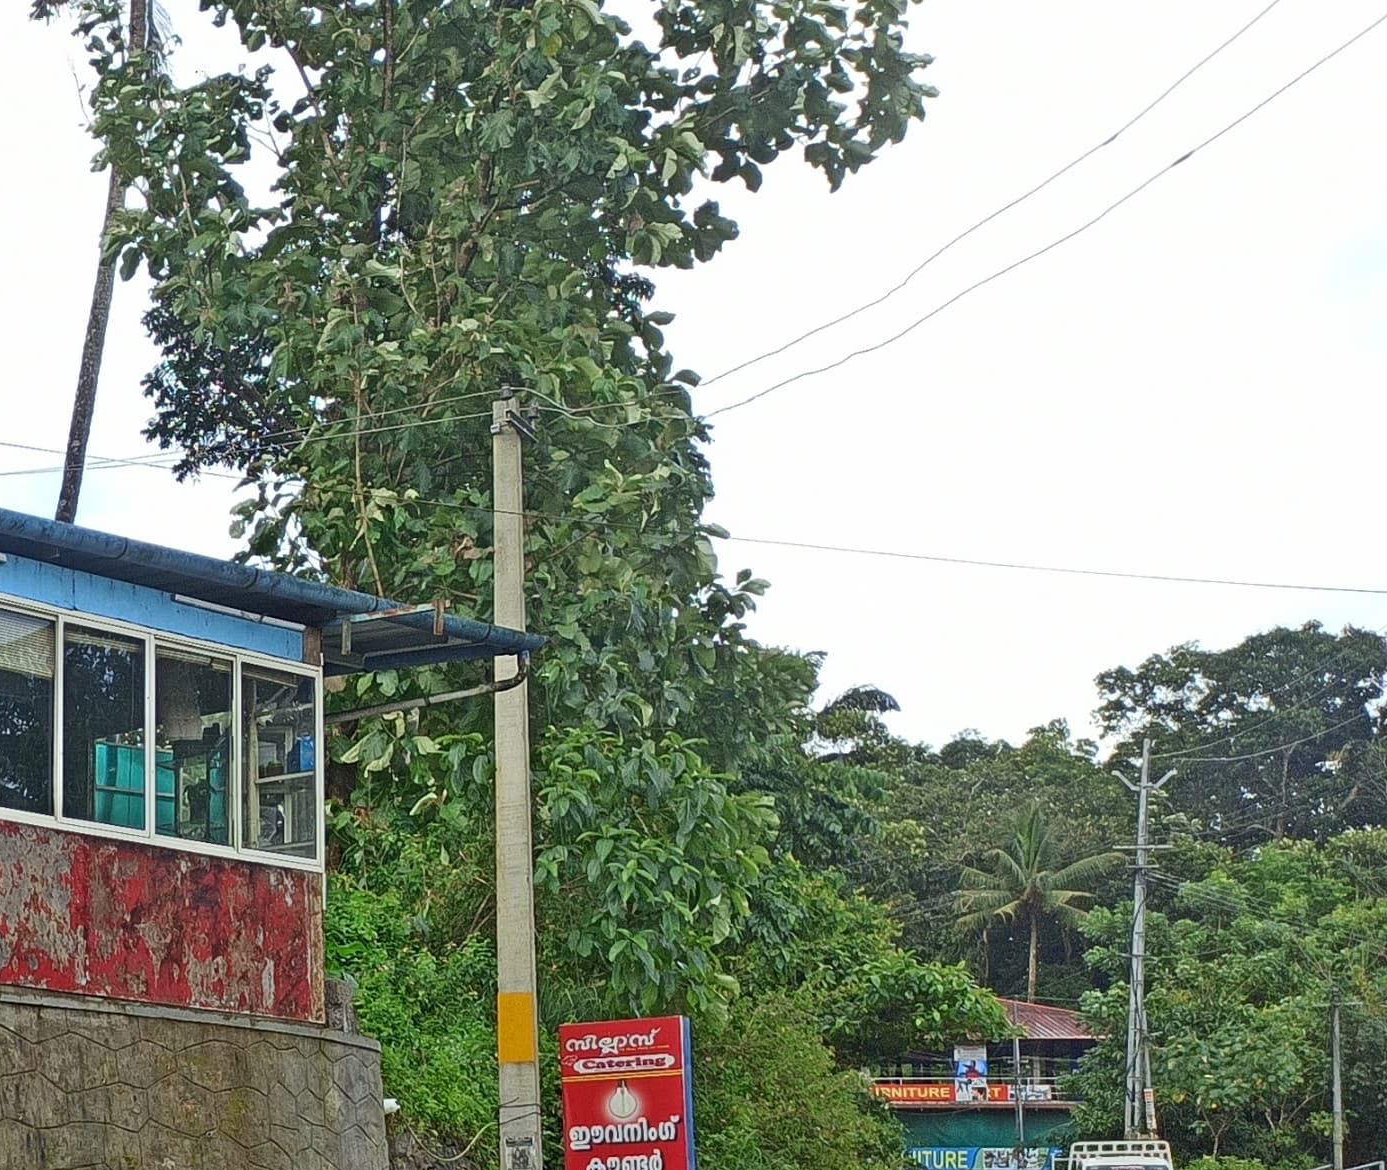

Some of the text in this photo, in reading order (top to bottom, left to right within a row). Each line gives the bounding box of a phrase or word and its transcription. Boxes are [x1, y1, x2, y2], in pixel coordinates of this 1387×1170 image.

[582, 1056, 667, 1071] Catering
[873, 1085, 951, 1099] RNITURE
[569, 1114, 680, 1151] ഈവനിംഗ്
